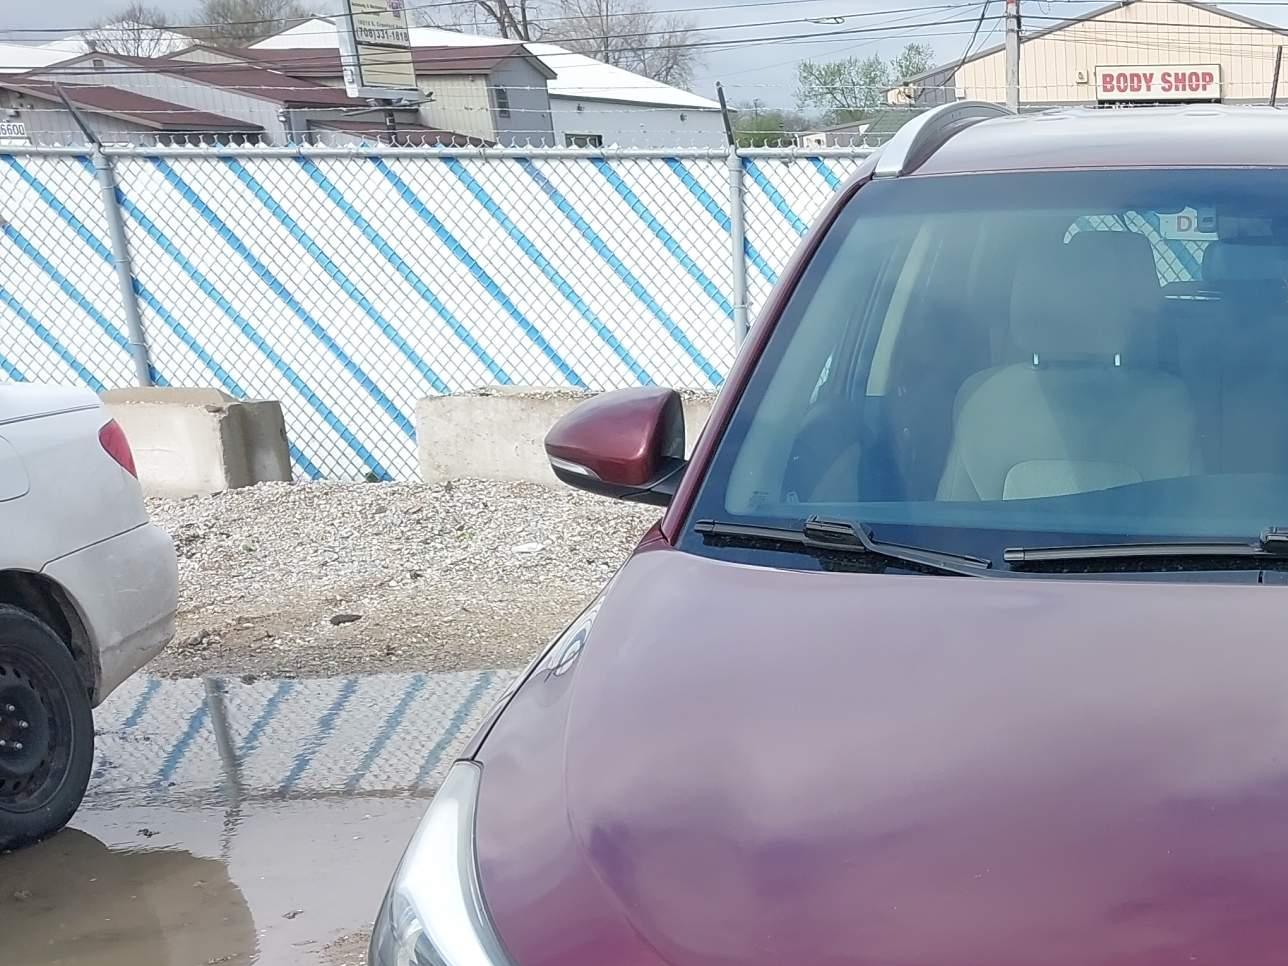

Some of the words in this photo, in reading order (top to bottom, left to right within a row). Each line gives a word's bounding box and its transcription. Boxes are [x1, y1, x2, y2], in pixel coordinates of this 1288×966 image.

[1102, 73, 1154, 92] BODY
[1161, 72, 1214, 92] SHOP
[0, 123, 25, 136] 6600
